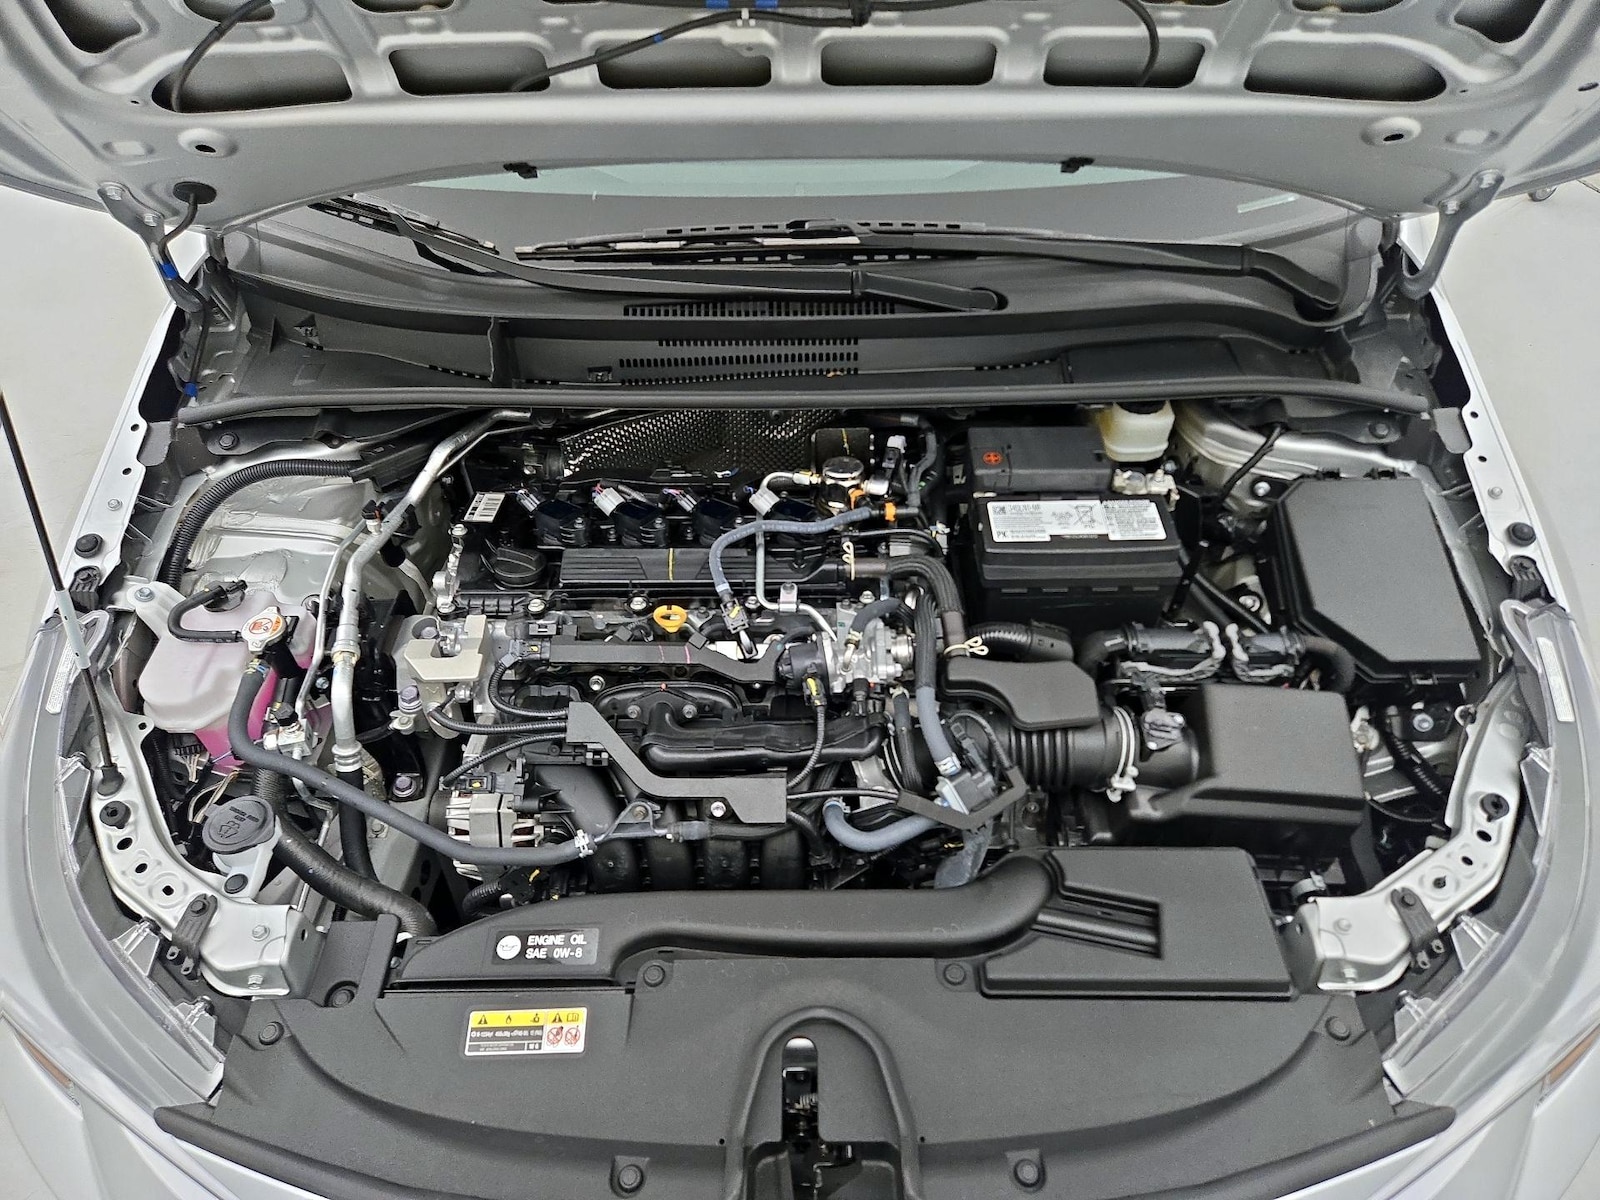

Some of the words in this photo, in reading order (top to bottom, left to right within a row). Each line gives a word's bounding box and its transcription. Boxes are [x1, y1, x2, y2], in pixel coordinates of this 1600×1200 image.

[527, 934, 565, 946] ENGINE
[570, 934, 587, 945] OIL
[525, 948, 547, 959] SAE
[553, 947, 583, 959] 0W-8
